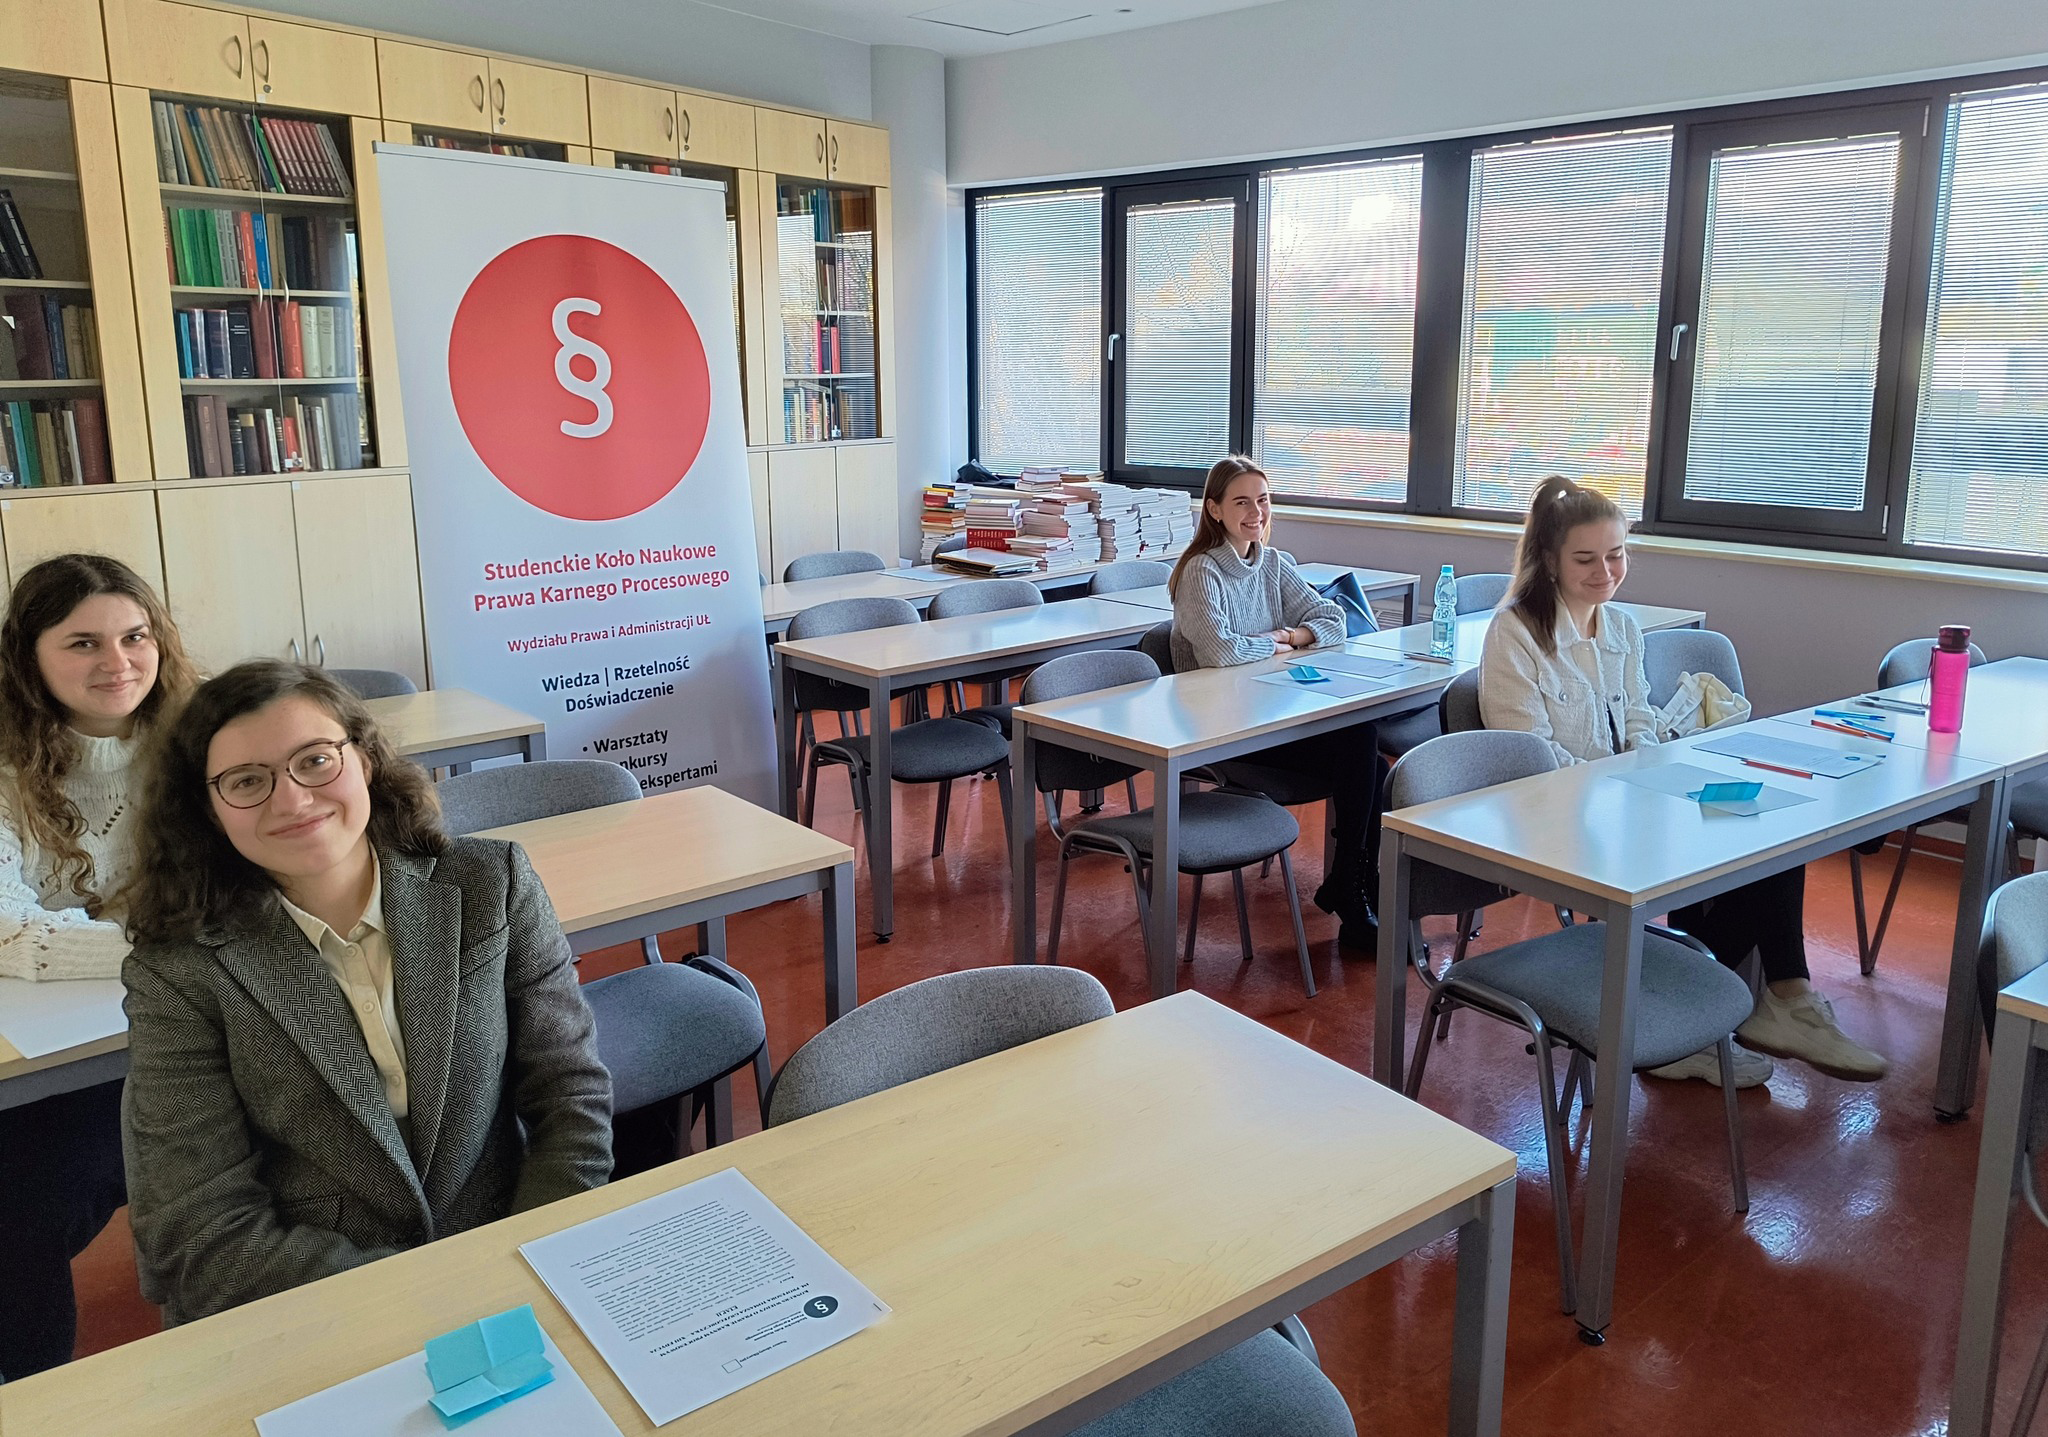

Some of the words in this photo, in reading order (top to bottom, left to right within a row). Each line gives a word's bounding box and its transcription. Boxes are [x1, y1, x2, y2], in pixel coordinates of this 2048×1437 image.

[484, 553, 591, 581] Studenckie
[595, 550, 635, 569] Koło
[639, 544, 716, 565] Naukowe
[474, 592, 535, 611] Prawa
[541, 582, 617, 604] Karnego
[621, 569, 729, 594] Procesowego
[507, 633, 568, 653] Wydziału
[571, 628, 609, 644] Prawa
[611, 626, 615, 638] i
[618, 615, 695, 637] Administracji
[696, 613, 711, 626] UŁ
[542, 672, 600, 693] Wiedza
[614, 655, 690, 681] Rzetelność
[565, 681, 675, 712] Doświadczenie
[593, 729, 669, 754] Warsztaty
[640, 760, 718, 790] ekspertami
